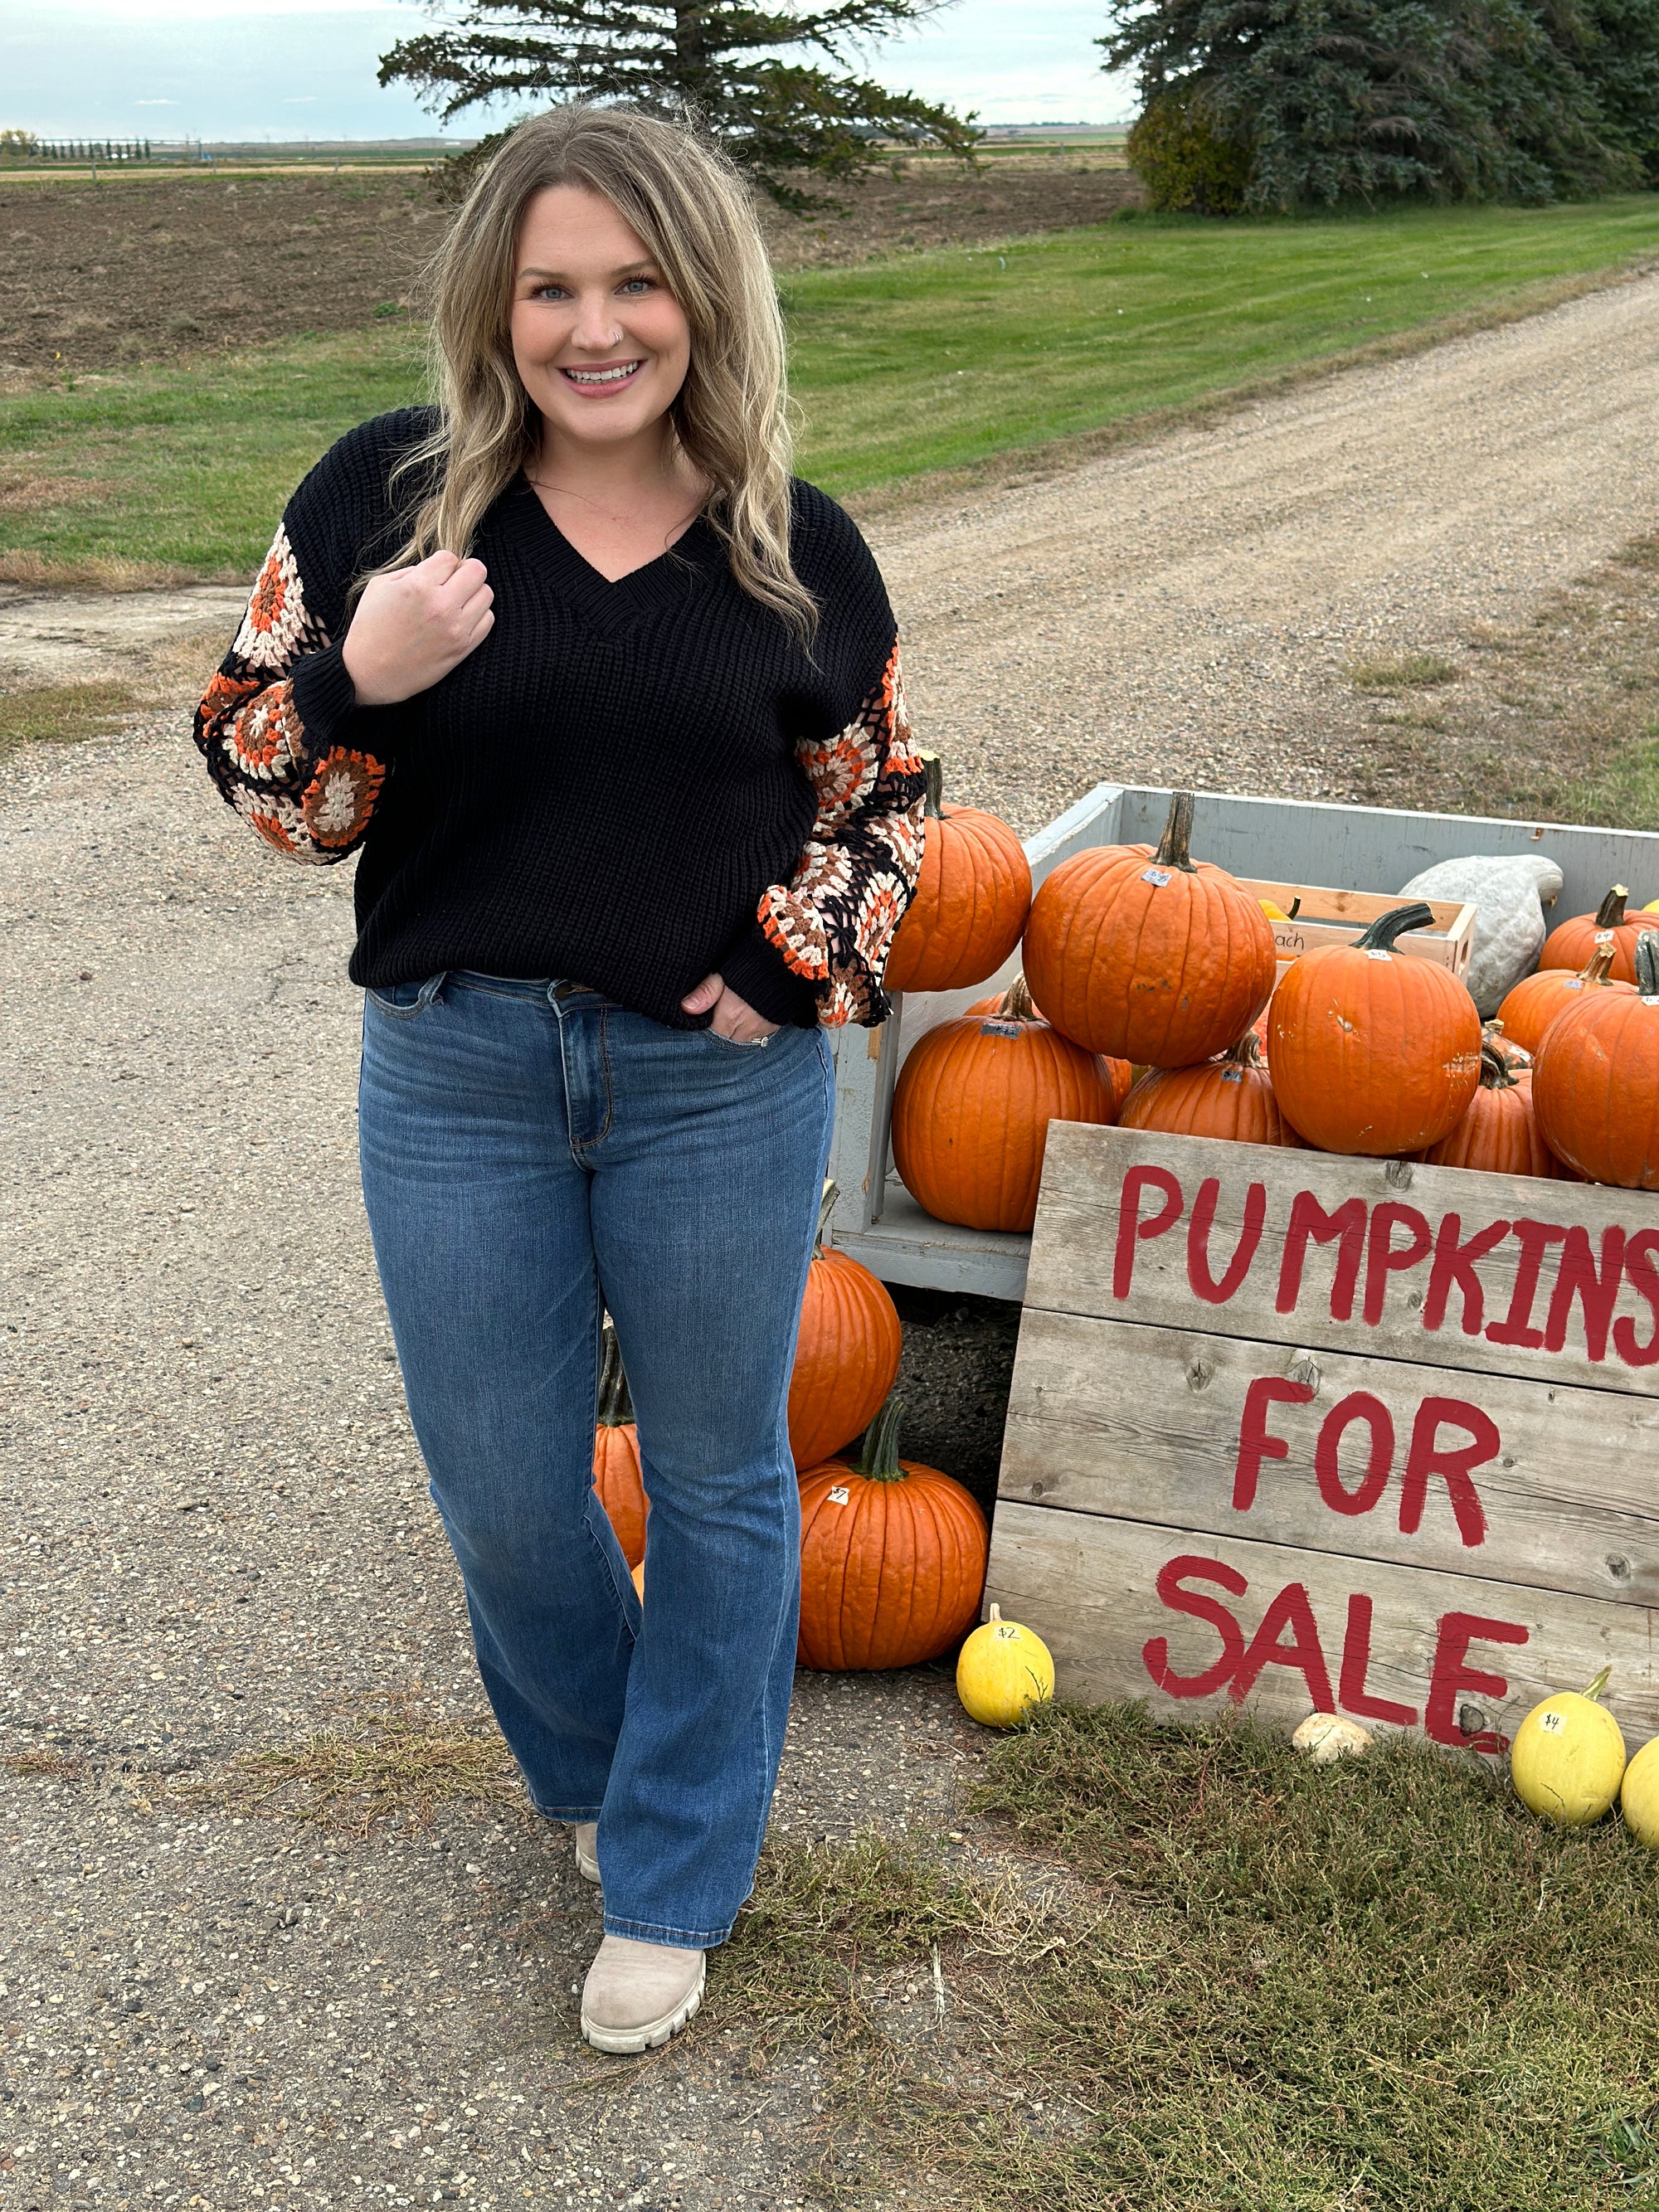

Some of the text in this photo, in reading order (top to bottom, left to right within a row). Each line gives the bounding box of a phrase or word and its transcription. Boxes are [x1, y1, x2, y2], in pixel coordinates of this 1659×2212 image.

[1274, 931, 1305, 950] ach
[1112, 1164, 1659, 1368] PUMPKINS
[1233, 1377, 1501, 1548] FOR
[833, 1488, 847, 1500] $7
[998, 1626, 1021, 1640] $2
[1141, 1554, 1530, 1755] SALE
[1545, 1713, 1559, 1730] $4
